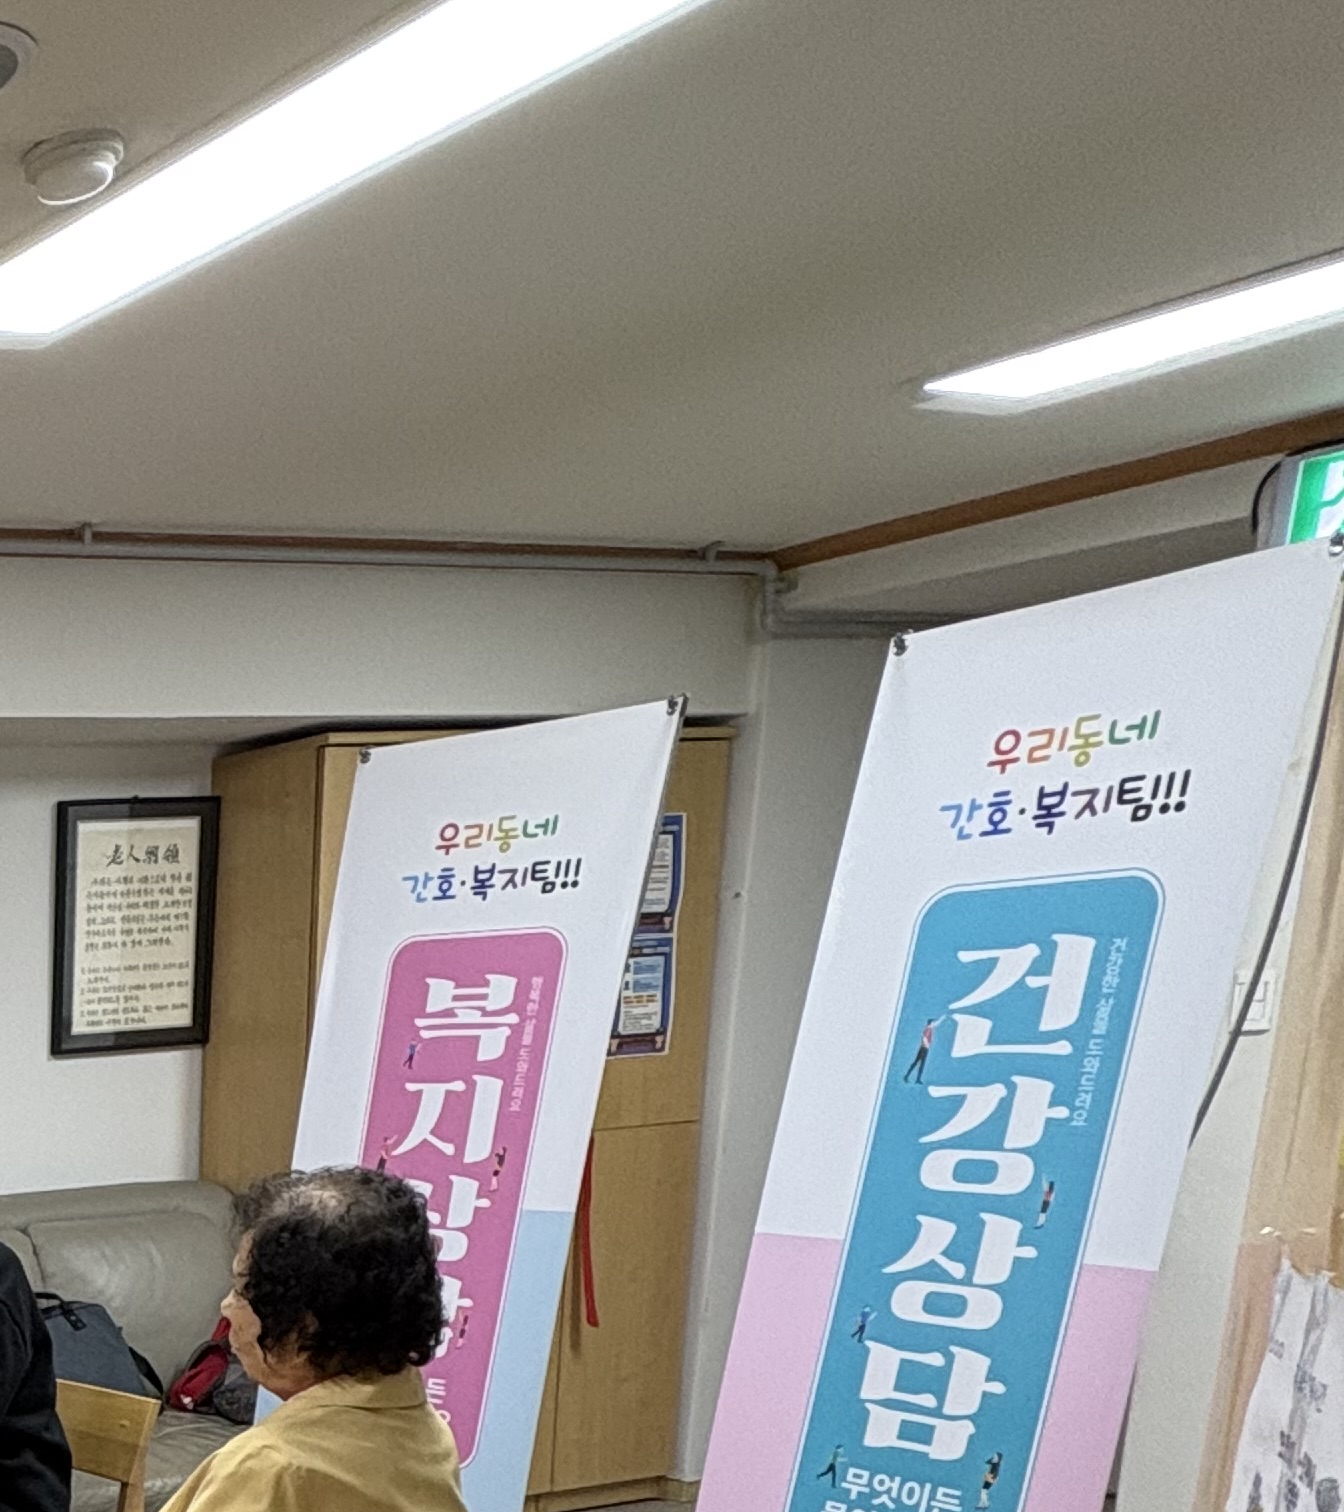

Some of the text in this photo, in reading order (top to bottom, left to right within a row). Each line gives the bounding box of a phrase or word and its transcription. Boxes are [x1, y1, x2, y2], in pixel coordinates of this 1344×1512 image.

[987, 710, 1161, 774] 우리동네
[435, 814, 559, 856] 우리동네
[858, 933, 1096, 1461] 건강상담
